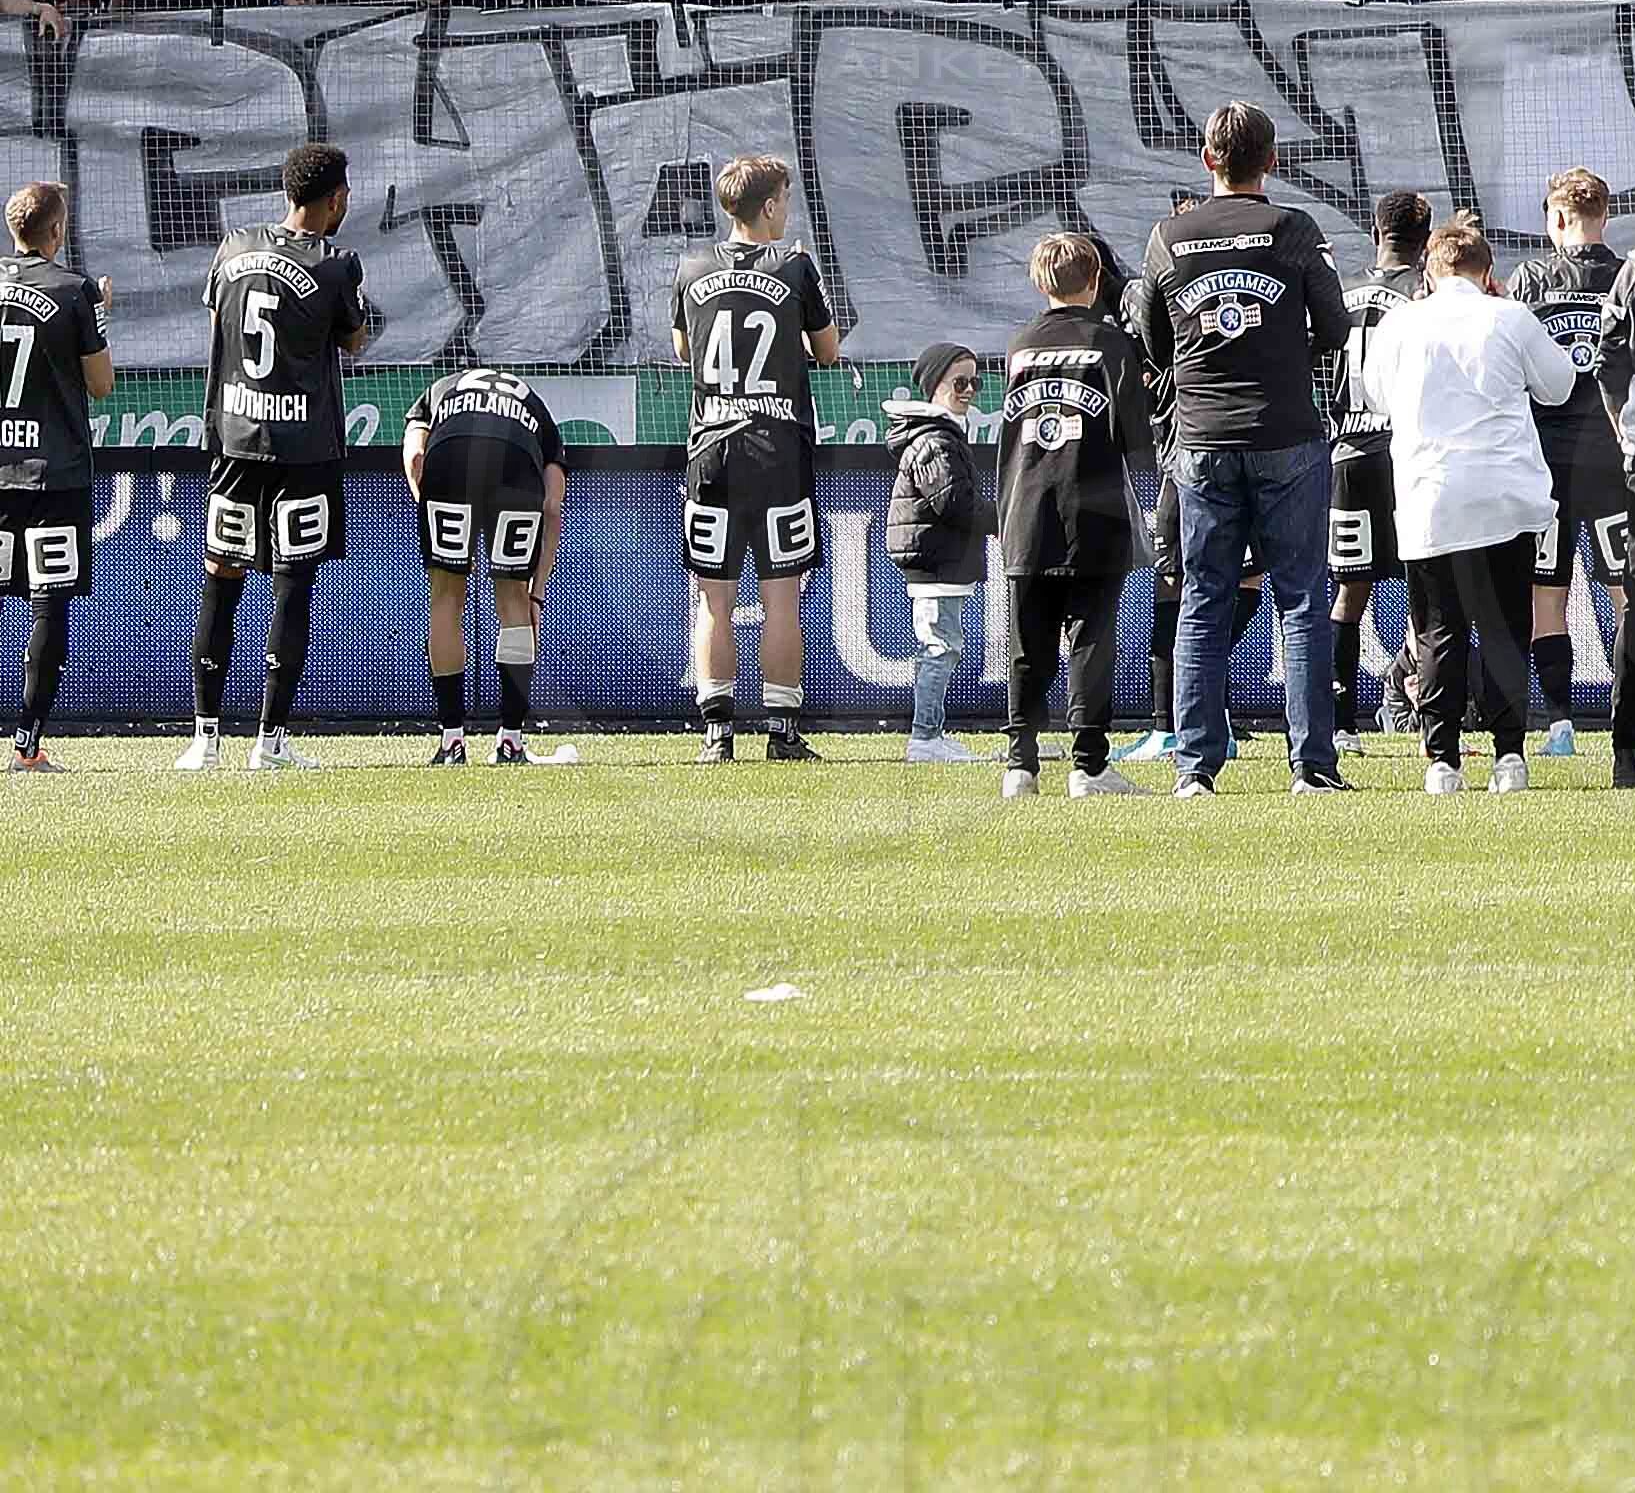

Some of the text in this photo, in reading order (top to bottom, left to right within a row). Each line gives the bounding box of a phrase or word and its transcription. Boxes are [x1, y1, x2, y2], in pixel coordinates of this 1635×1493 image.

[228, 253, 314, 297] PUNTIGAMER
[694, 271, 787, 303] PUNTIGAMER
[1178, 270, 1284, 312] PUNTIGAMER
[239, 288, 280, 380] 5
[702, 309, 778, 395] 42
[222, 381, 308, 423] WÜTHRICH
[1004, 377, 1109, 420] PUNTIGAMER
